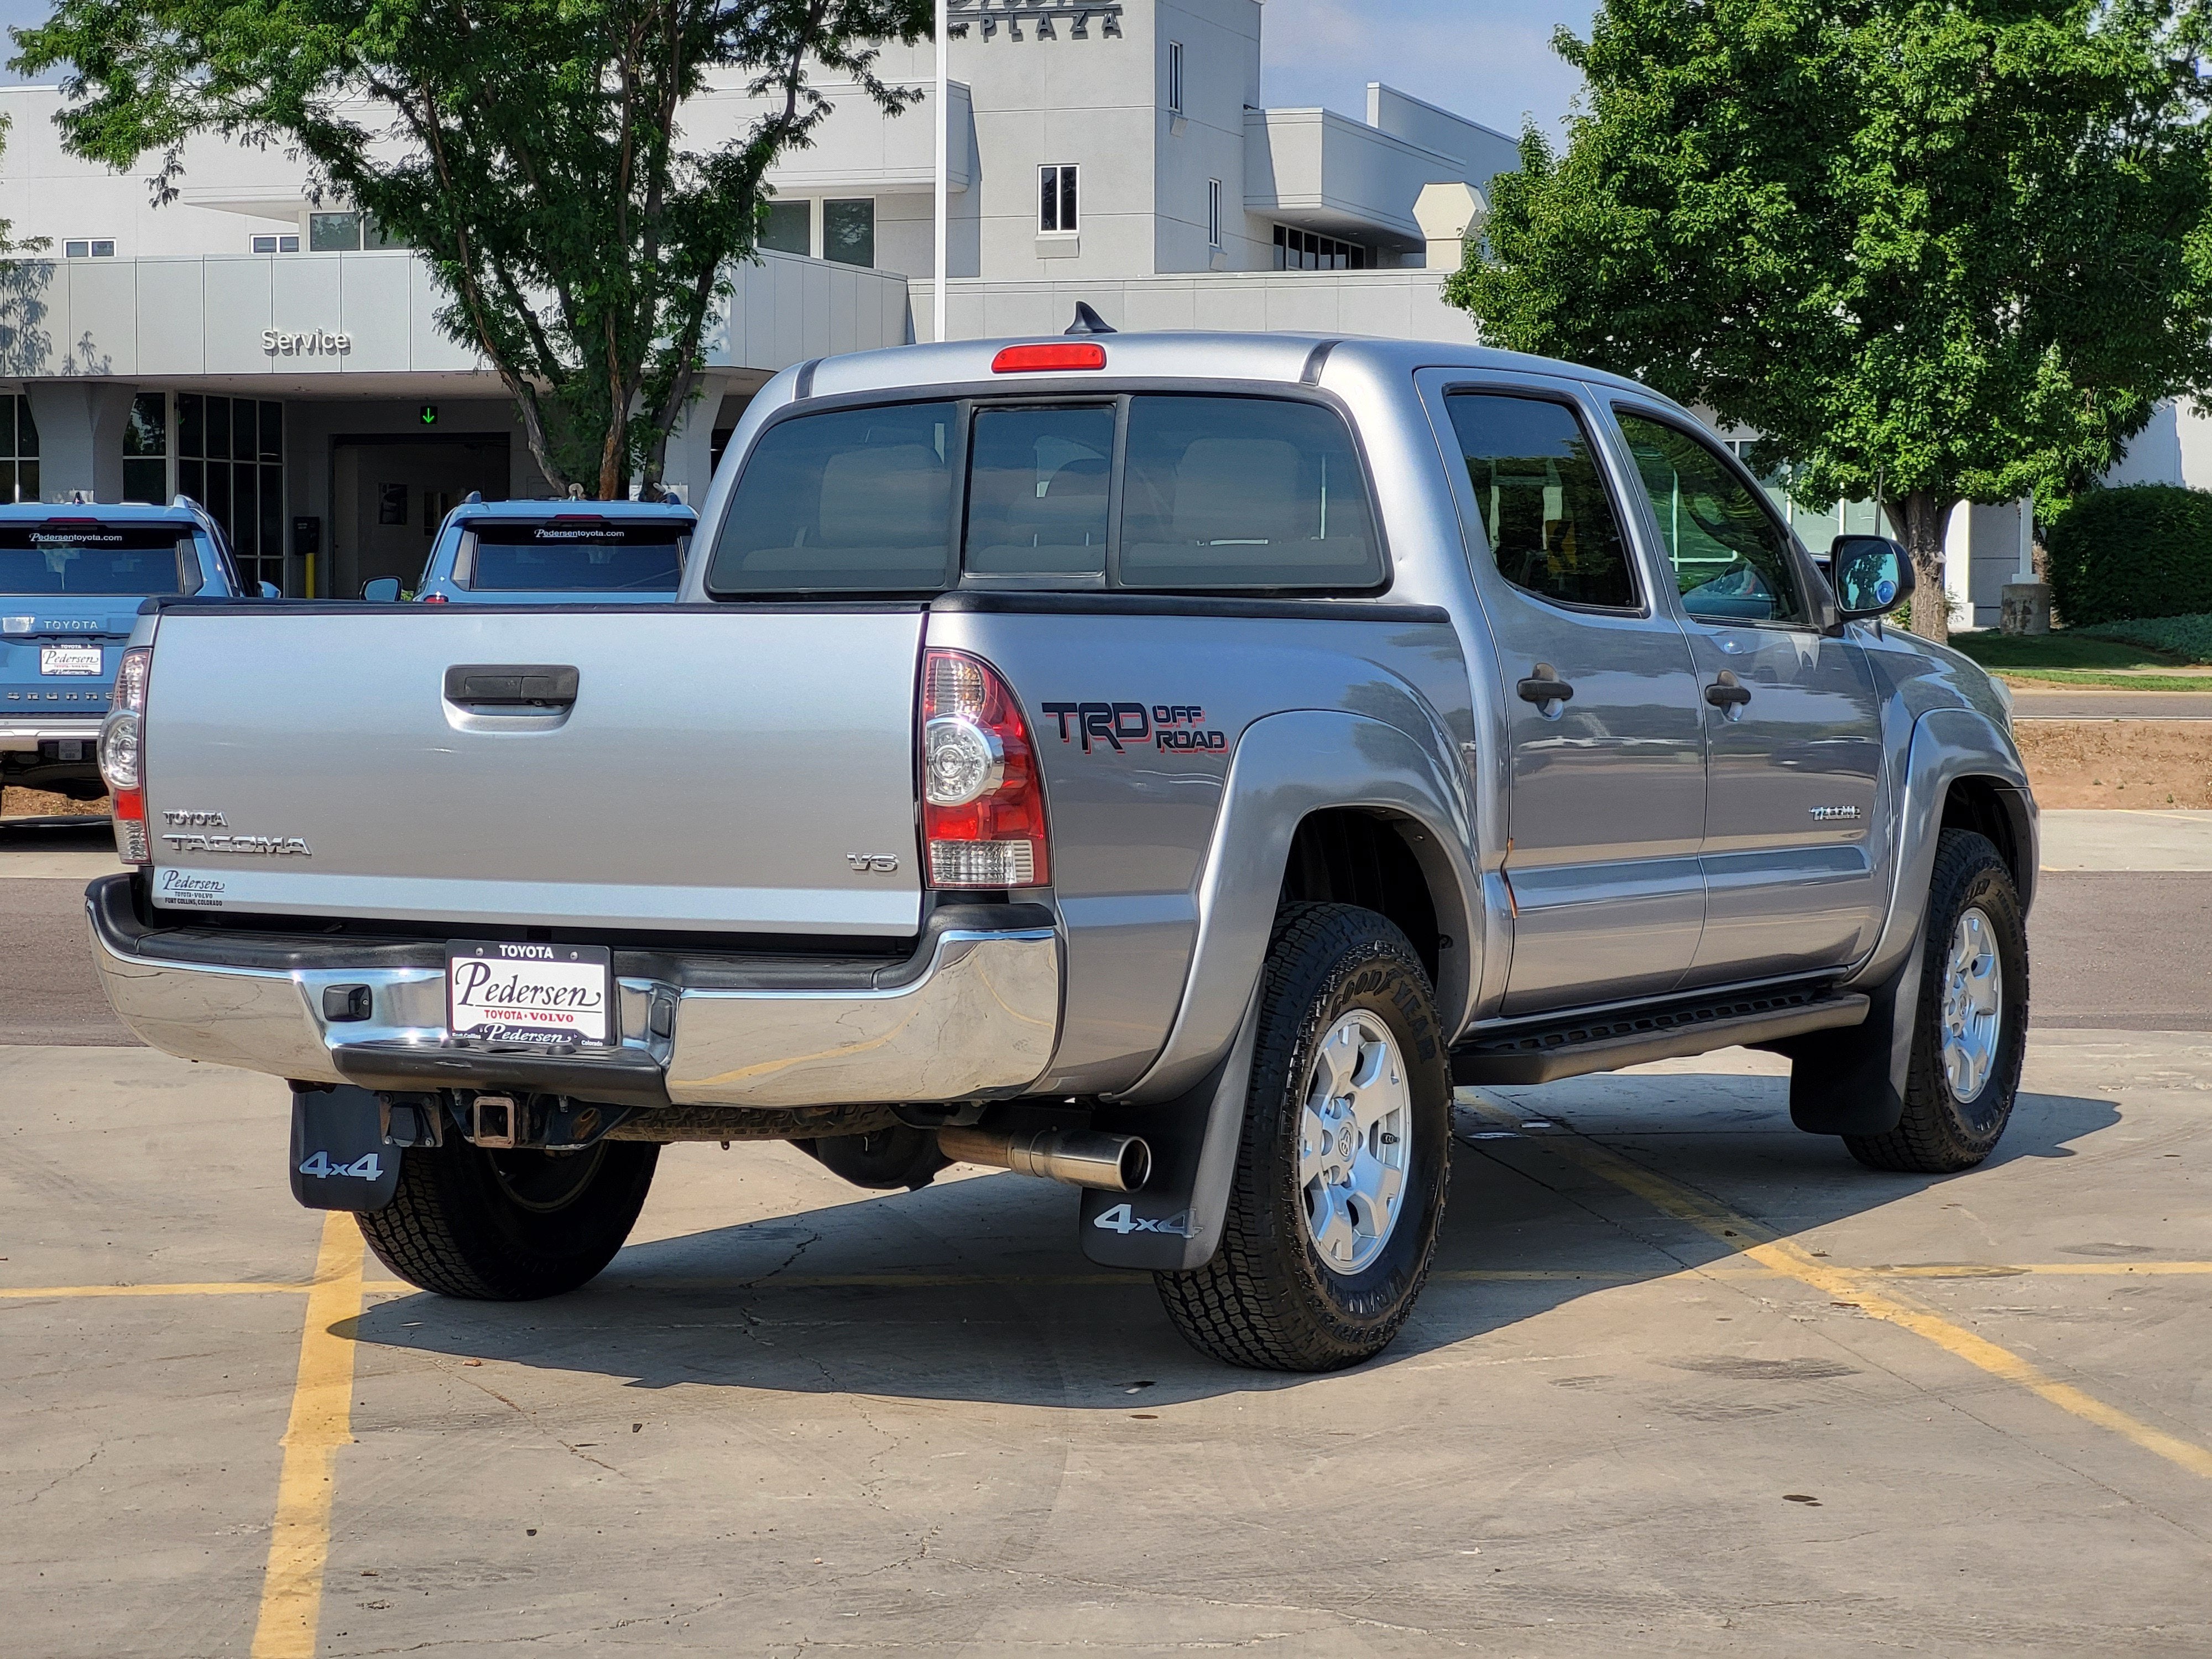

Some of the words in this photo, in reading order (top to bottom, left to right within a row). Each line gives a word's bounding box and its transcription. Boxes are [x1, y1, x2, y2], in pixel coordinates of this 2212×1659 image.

[979, 11, 1121, 39] PLAZA
[261, 328, 349, 351] Service
[29, 533, 122, 542] Pedersentoyota.com
[534, 529, 624, 538] Pedersentoyota.com
[44, 620, 98, 629] TOYOTA
[43, 650, 98, 664] Pedersen
[1042, 702, 1152, 754] TRD
[1152, 706, 1205, 728] OFF
[1156, 731, 1228, 753] ROAD
[162, 810, 228, 827] TOYOTA
[161, 833, 312, 855] TACOMA
[846, 852, 899, 871] V6
[163, 870, 225, 890] Pedersen
[499, 945, 554, 959] TOYOTA
[455, 962, 601, 1006] Pedersen
[484, 1010, 523, 1020] TOYOTA
[529, 1012, 573, 1022] VOLVO
[1331, 968, 1437, 1065] GOODYEAR
[484, 1023, 571, 1043] Pedersen
[299, 1151, 384, 1181] 4x4
[1093, 1203, 1204, 1239] 4x4
